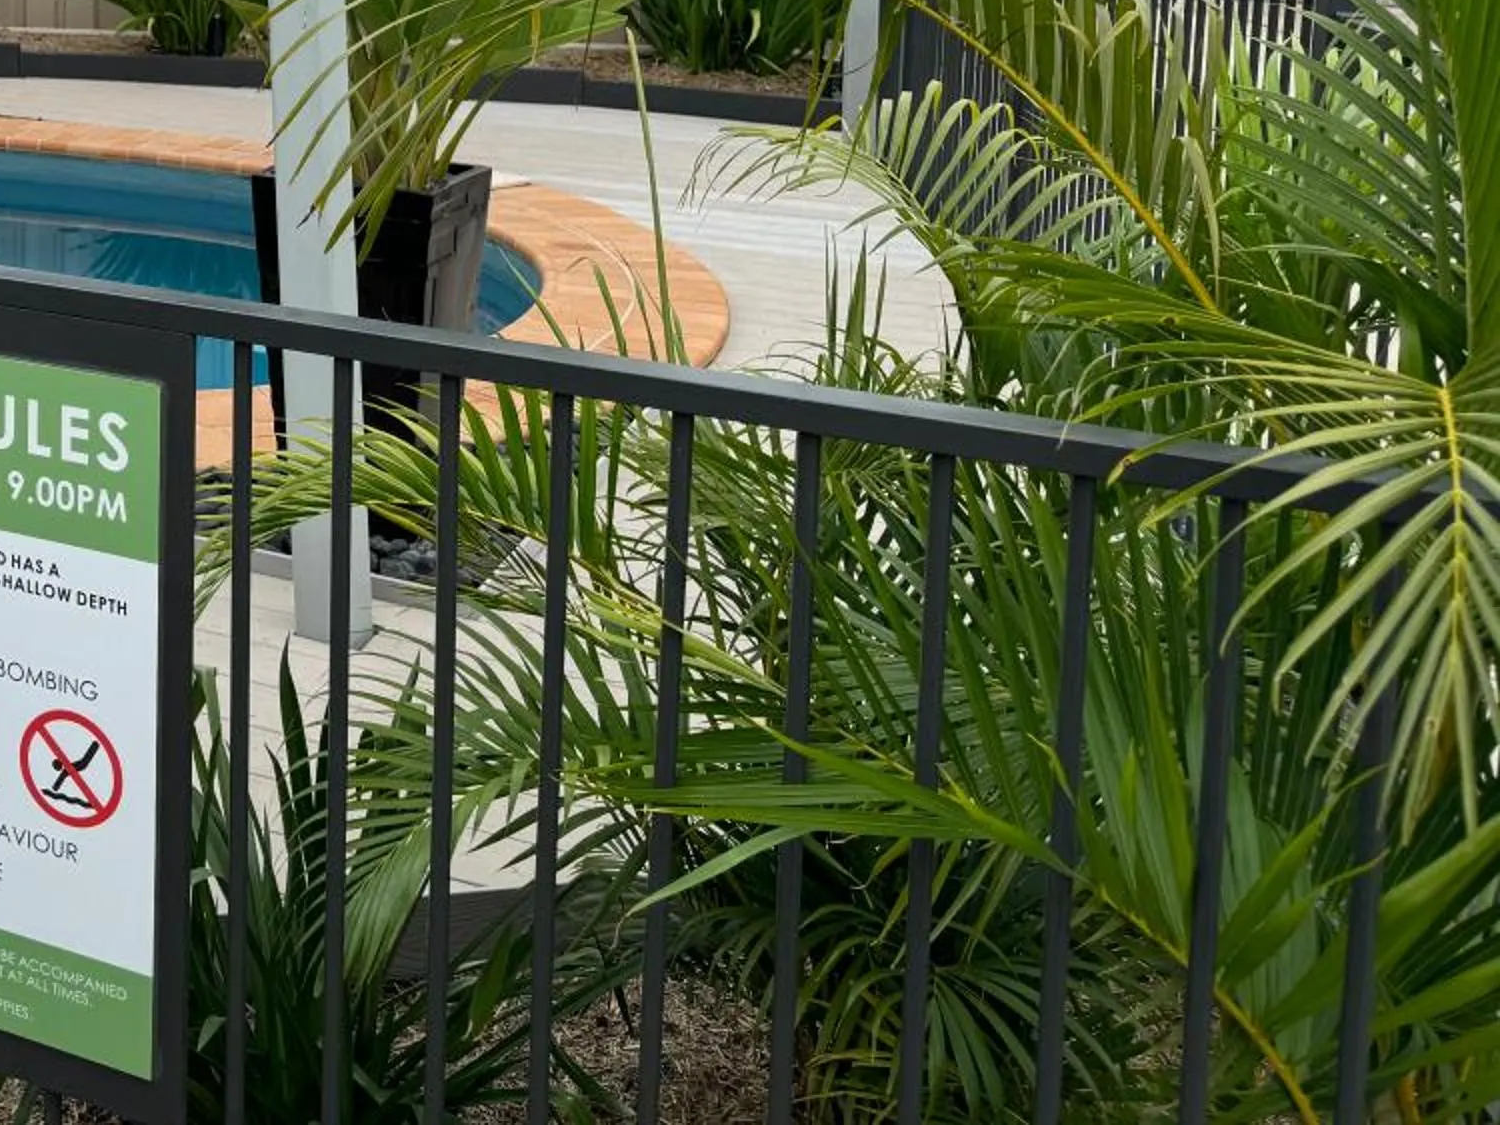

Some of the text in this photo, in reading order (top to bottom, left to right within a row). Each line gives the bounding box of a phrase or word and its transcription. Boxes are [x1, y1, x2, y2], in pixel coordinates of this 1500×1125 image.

[6, 467, 127, 524] 9.00PM
[10, 551, 43, 574] HAS
[47, 559, 60, 578] A
[76, 588, 128, 615] DEPTH
